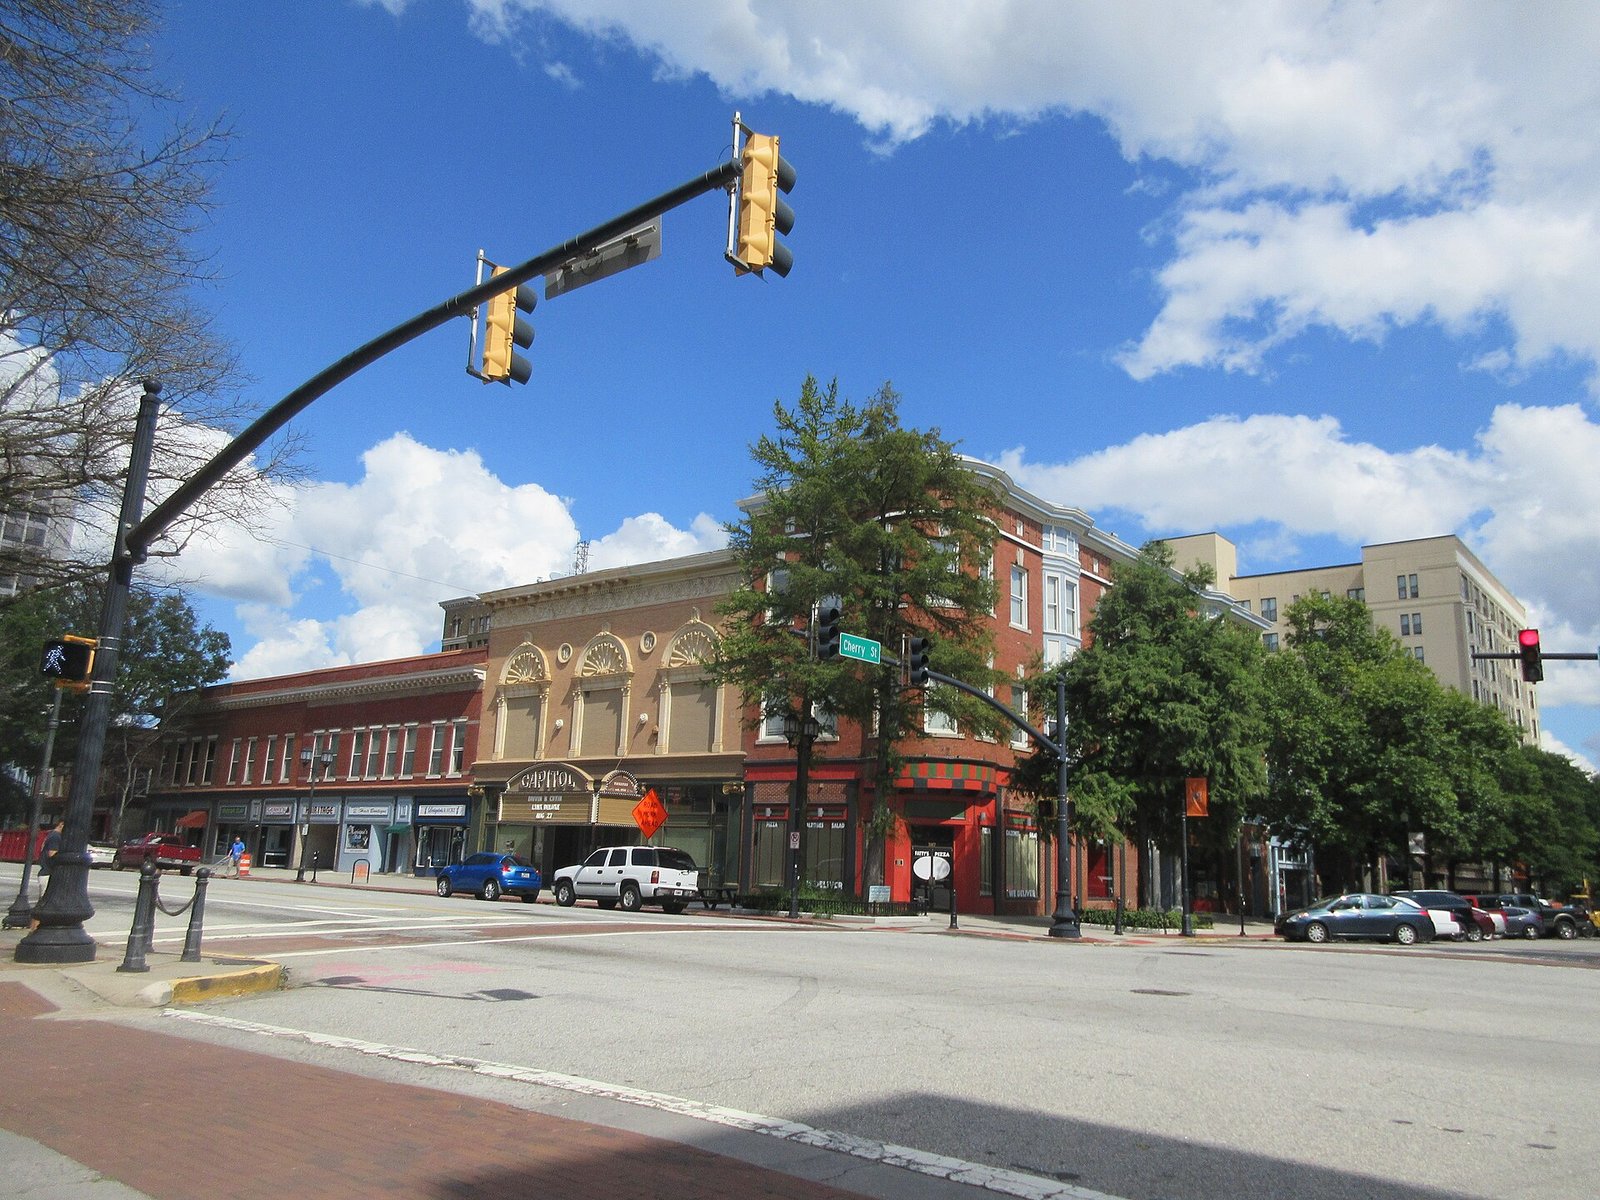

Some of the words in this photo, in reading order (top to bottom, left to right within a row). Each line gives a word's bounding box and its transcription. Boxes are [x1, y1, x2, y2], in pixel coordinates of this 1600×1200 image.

[843, 639, 866, 657] Cherry
[870, 646, 878, 658] St
[521, 769, 576, 789] CAPITOL
